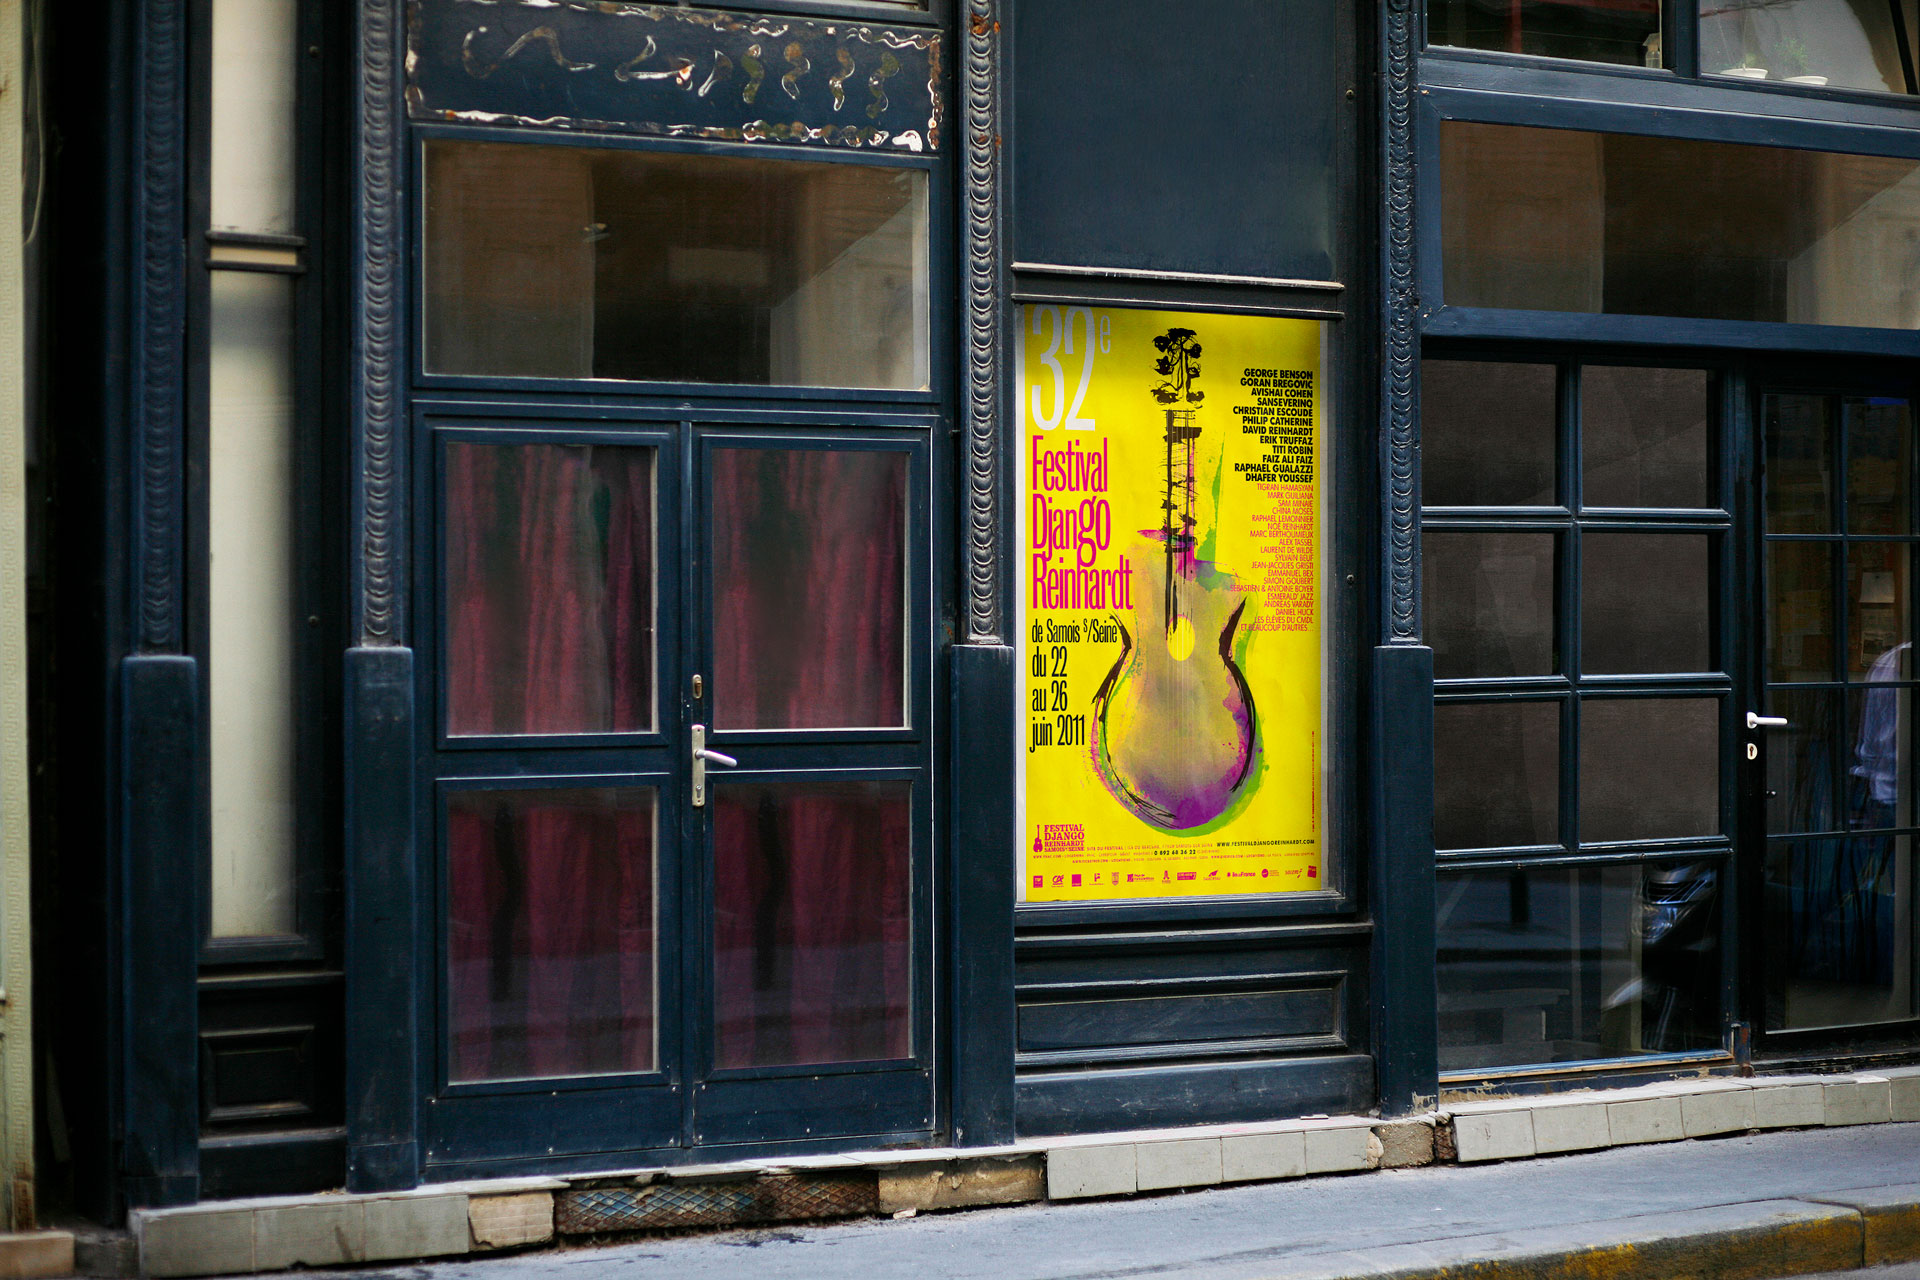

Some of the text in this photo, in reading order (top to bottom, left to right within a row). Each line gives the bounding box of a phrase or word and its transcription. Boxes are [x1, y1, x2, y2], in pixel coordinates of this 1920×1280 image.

[1244, 368, 1313, 379] GEORGE BENSON
[1241, 378, 1313, 389] GORAN BREGOVIC
[1251, 388, 1313, 398] AVISHAI COHEN
[1258, 398, 1313, 407] SANSEVERINO
[1233, 406, 1313, 417] CHRISTIAN ESCOUDE
[1243, 416, 1313, 426] PHILIP CATHERINE
[1243, 426, 1313, 436] DAVID REINHARDT
[1260, 436, 1313, 445] ERIK TRUFFAZ
[1288, 446, 1313, 455] ROBIN
[1032, 435, 1108, 492] Festival
[1263, 455, 1313, 464] FAIZ ALI FAIZ
[1235, 463, 1313, 473] RAPHAEL GUALAZZI
[1246, 473, 1313, 483] DHAFER YOUSSEF
[1032, 494, 1111, 567] Django
[1032, 553, 1133, 610] Reinhardt
[1032, 619, 1043, 642] de
[1047, 619, 1080, 642] Samois
[1033, 646, 1067, 677] du 22
[1032, 680, 1067, 711] au 26
[1030, 714, 1084, 753] juin 2011
[1044, 824, 1084, 832] FESTIVAL
[1044, 832, 1084, 840] DJANGO
[1217, 839, 1314, 847] WWW.FESTIVALDJANGOREINHARDT.COM
